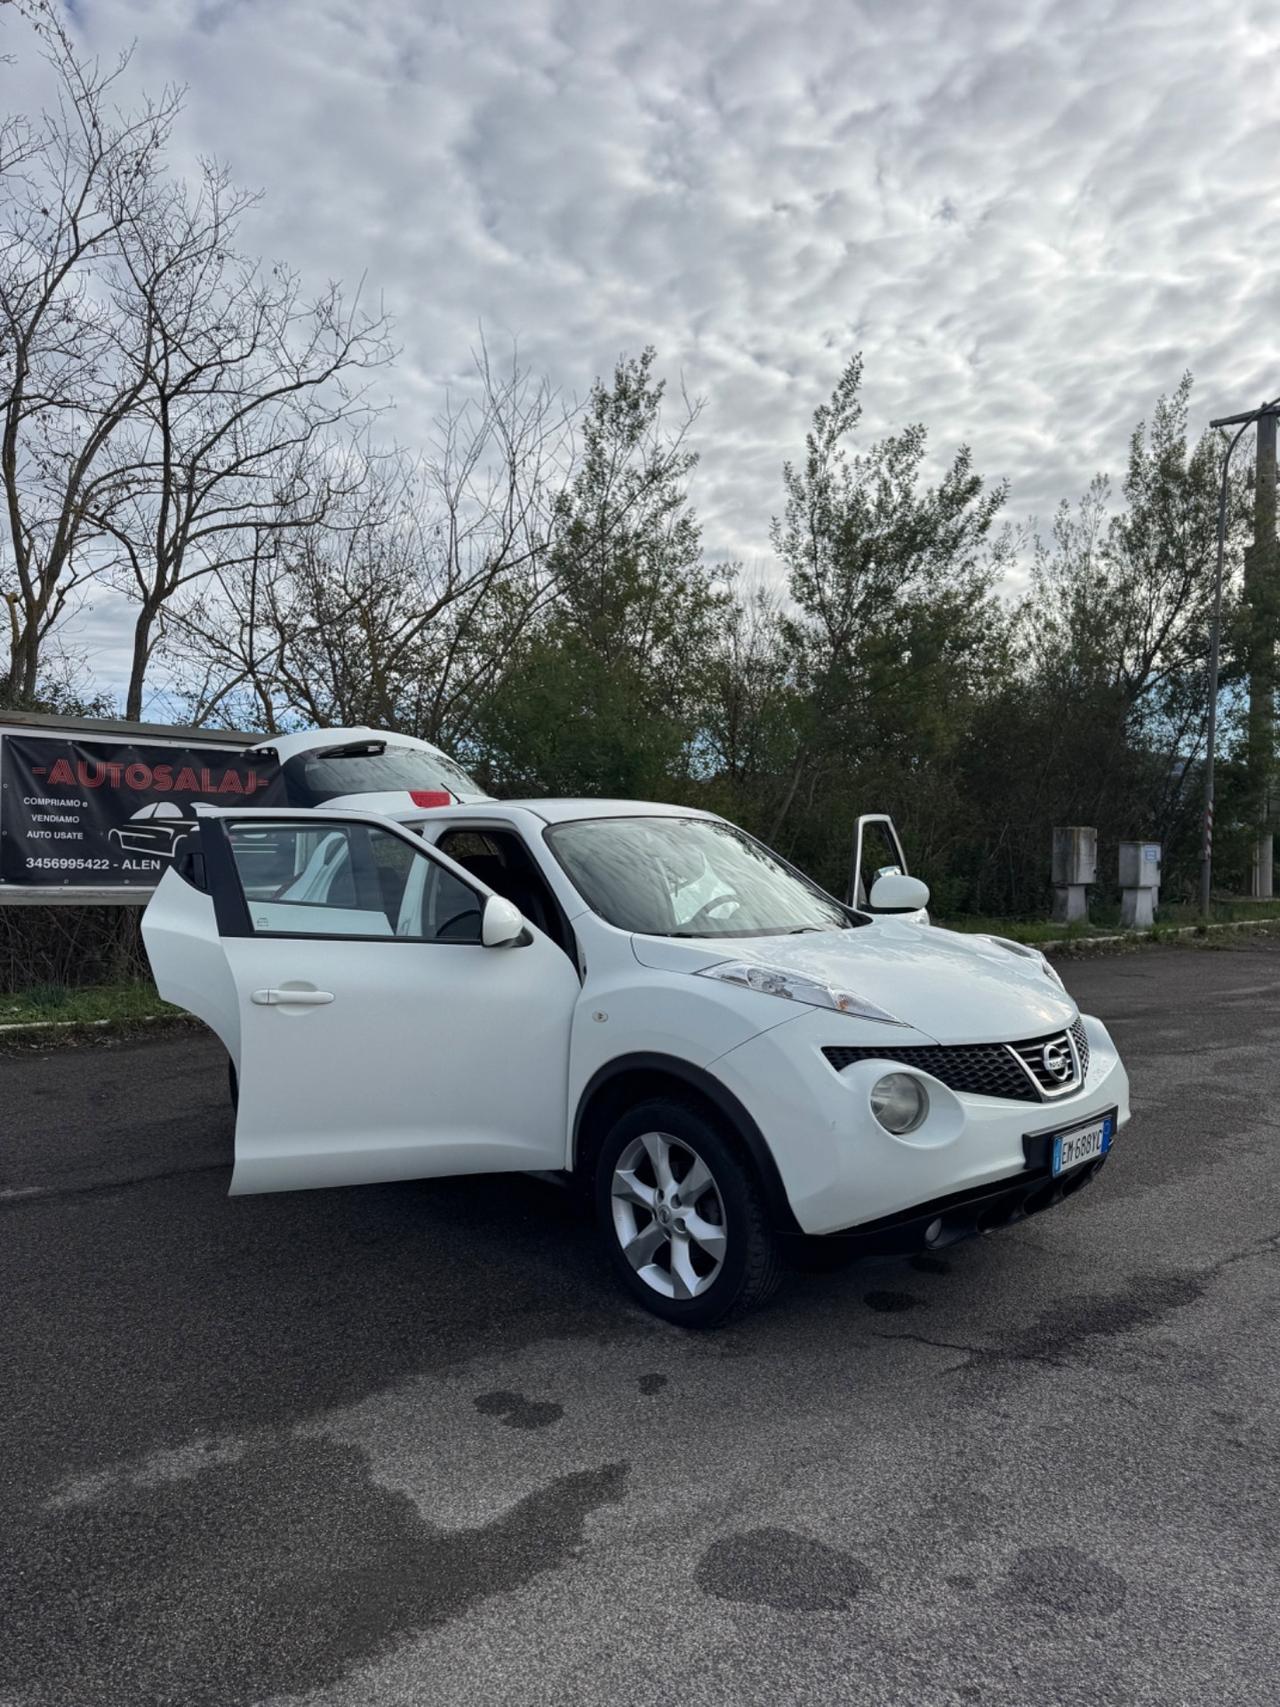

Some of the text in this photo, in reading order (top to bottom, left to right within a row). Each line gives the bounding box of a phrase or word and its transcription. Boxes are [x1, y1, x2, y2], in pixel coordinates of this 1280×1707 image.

[23, 796, 81, 808] COMPRIAMO
[31, 814, 80, 824] VENDIAMO
[26, 830, 84, 840] AUTO USATE
[25, 857, 110, 870] 3456995422
[121, 858, 161, 870] ALEN
